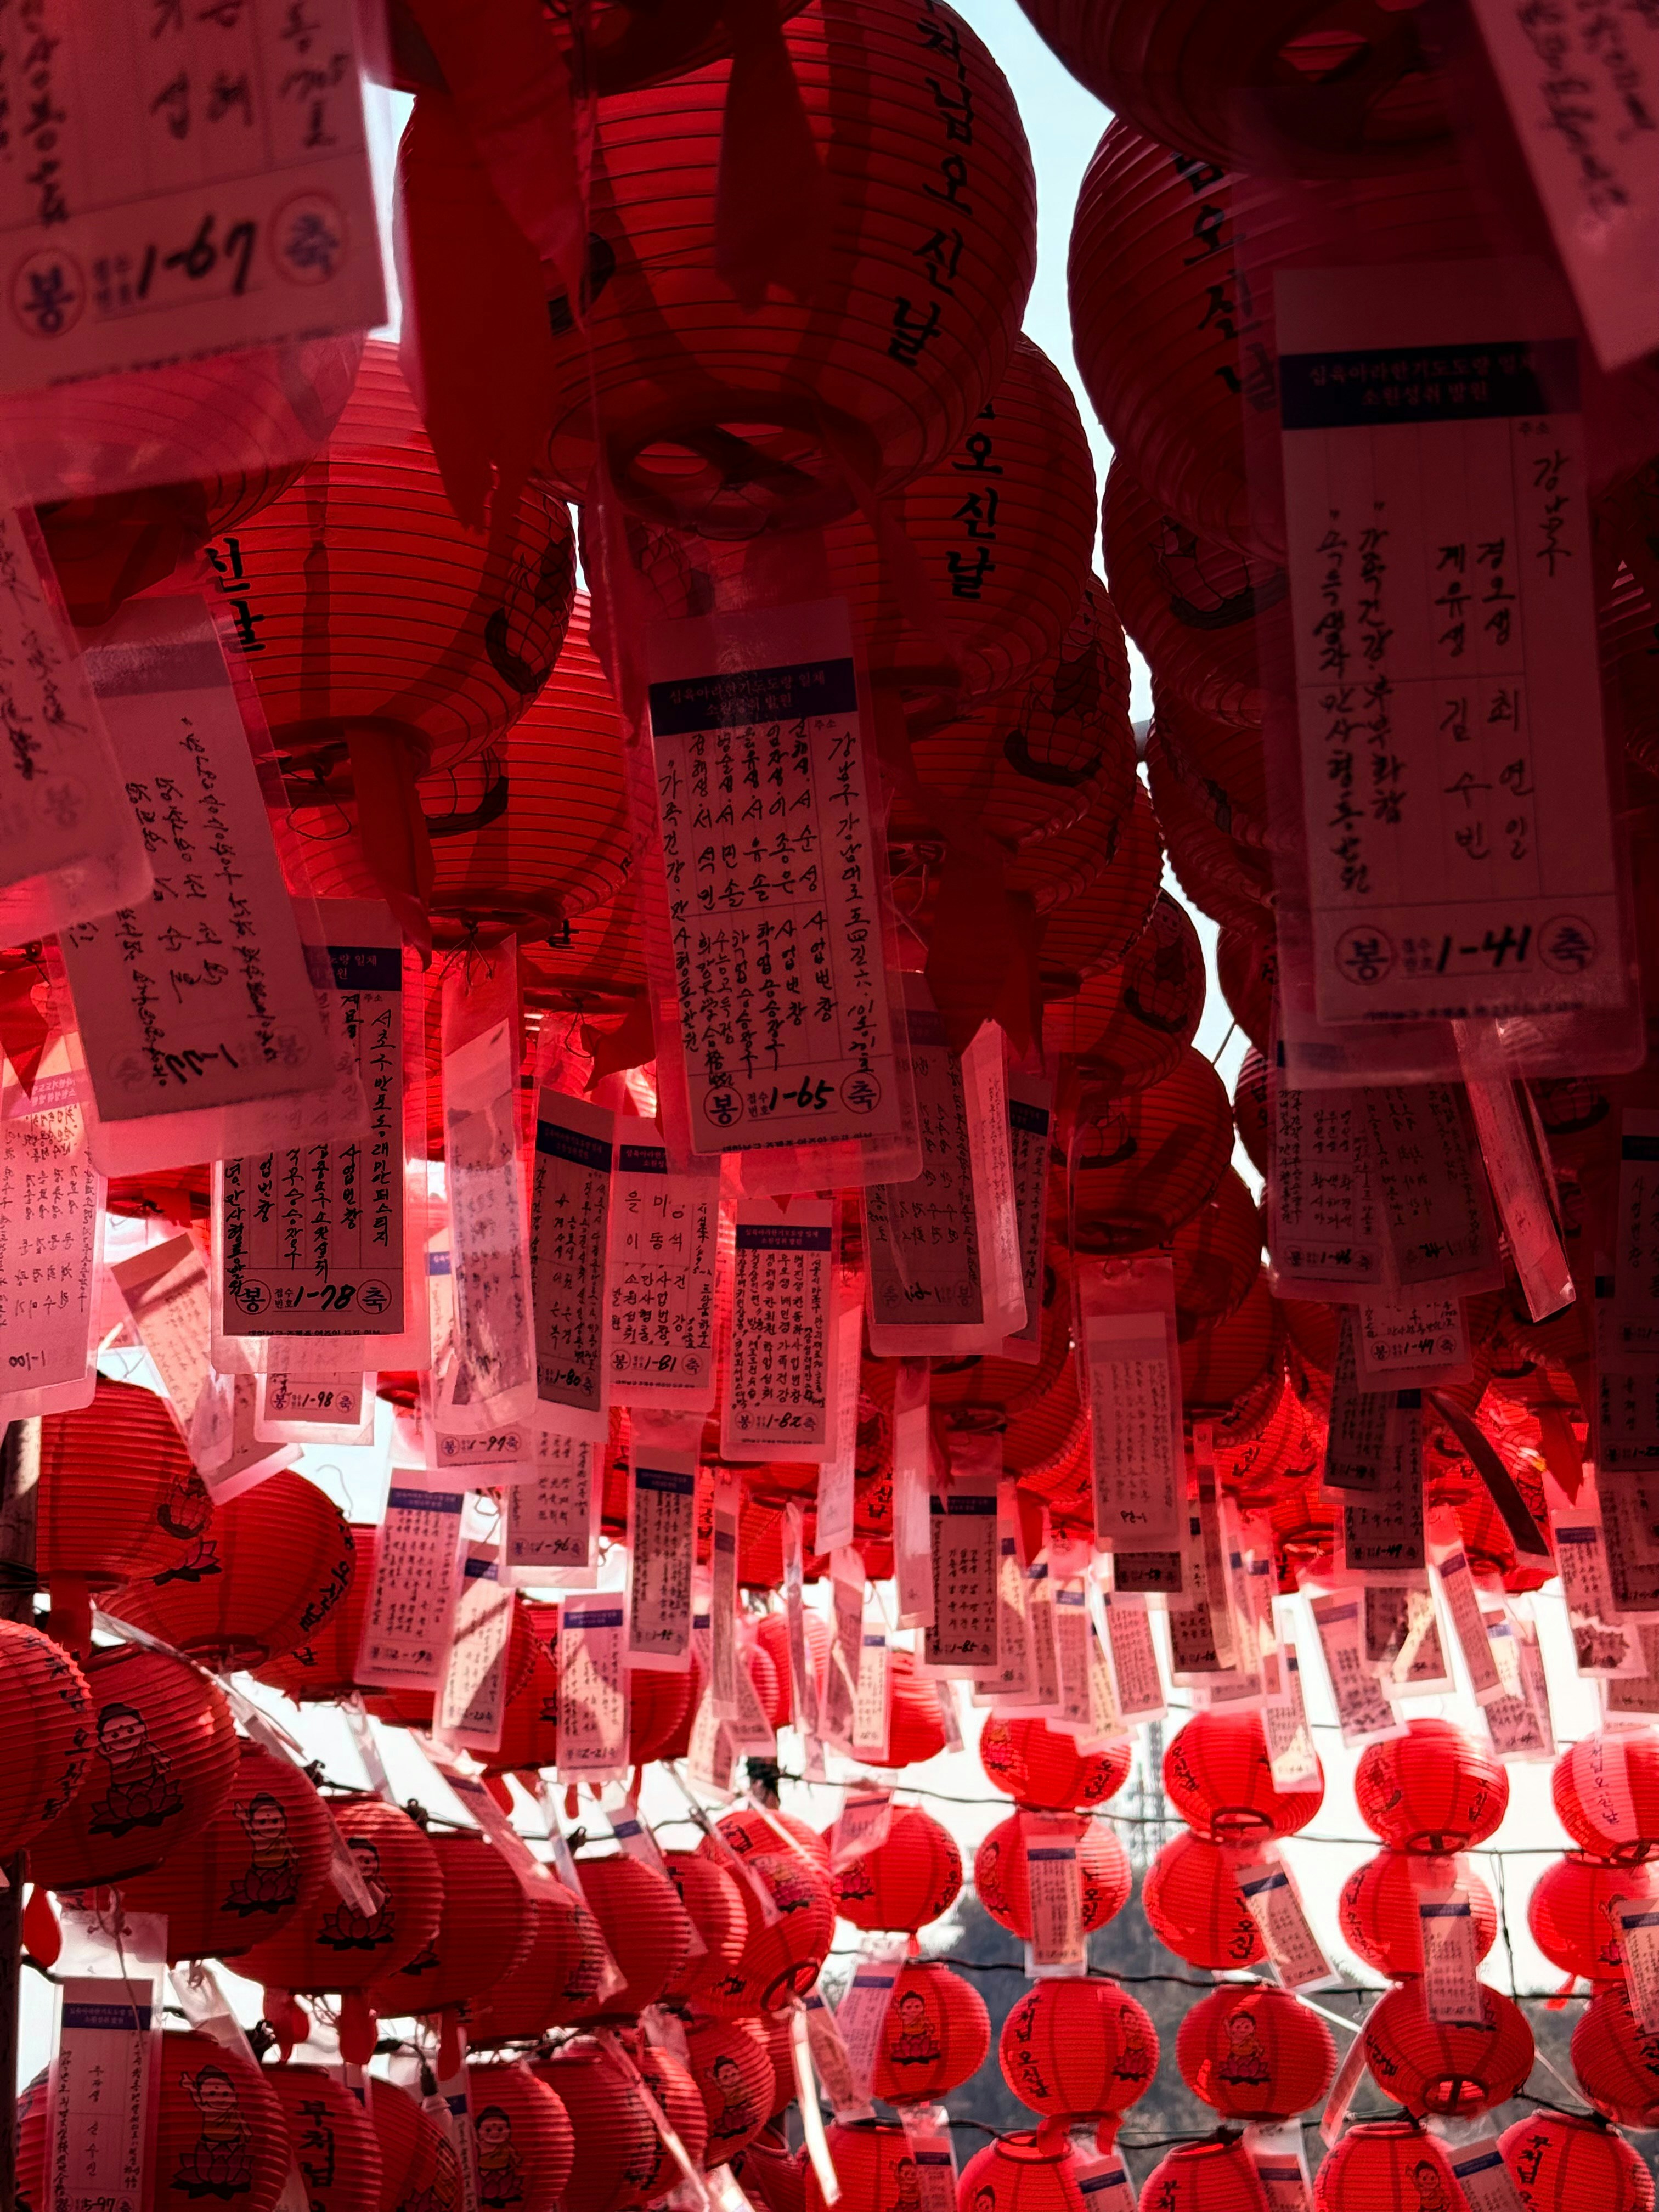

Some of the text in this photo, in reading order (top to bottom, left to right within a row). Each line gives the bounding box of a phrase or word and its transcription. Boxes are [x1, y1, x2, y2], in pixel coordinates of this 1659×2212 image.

[889, 0, 974, 366] 처님오신날
[137, 216, 256, 296] 1-67
[24, 266, 74, 332] 봉
[1361, 380, 1487, 406] 소원성취 발원
[1518, 421, 1551, 436] 주소
[946, 404, 1003, 599] 오신날
[814, 719, 836, 729] 주소
[356, 955, 377, 966] 입재
[1346, 939, 1388, 980] 봉
[1437, 926, 1531, 973] 1-41
[774, 919, 806, 1025] 사업번창
[803, 911, 838, 1022] 사업번창
[364, 994, 383, 1002] 주소
[769, 1076, 835, 1110] 1-65
[849, 1080, 877, 1110] 축
[709, 1093, 738, 1124] 봉
[253, 1153, 275, 1222] 업번창
[339, 1144, 363, 1229] 사업번창
[240, 1287, 266, 1312] 봉
[293, 1284, 356, 1311] 1-78
[362, 1286, 387, 1312] 축
[614, 1355, 627, 1369] 봉
[643, 1354, 678, 1372] 1-81
[776, 1339, 790, 1403] 가족건강
[790, 1338, 803, 1404] 사업번창
[552, 1368, 580, 1386] 1-80
[302, 1391, 334, 1408] 1-98
[738, 1415, 751, 1429] 봉
[766, 1412, 802, 1429] 1-82
[535, 1537, 571, 1554] 1-96
[83, 2197, 116, 2211] 5-97
